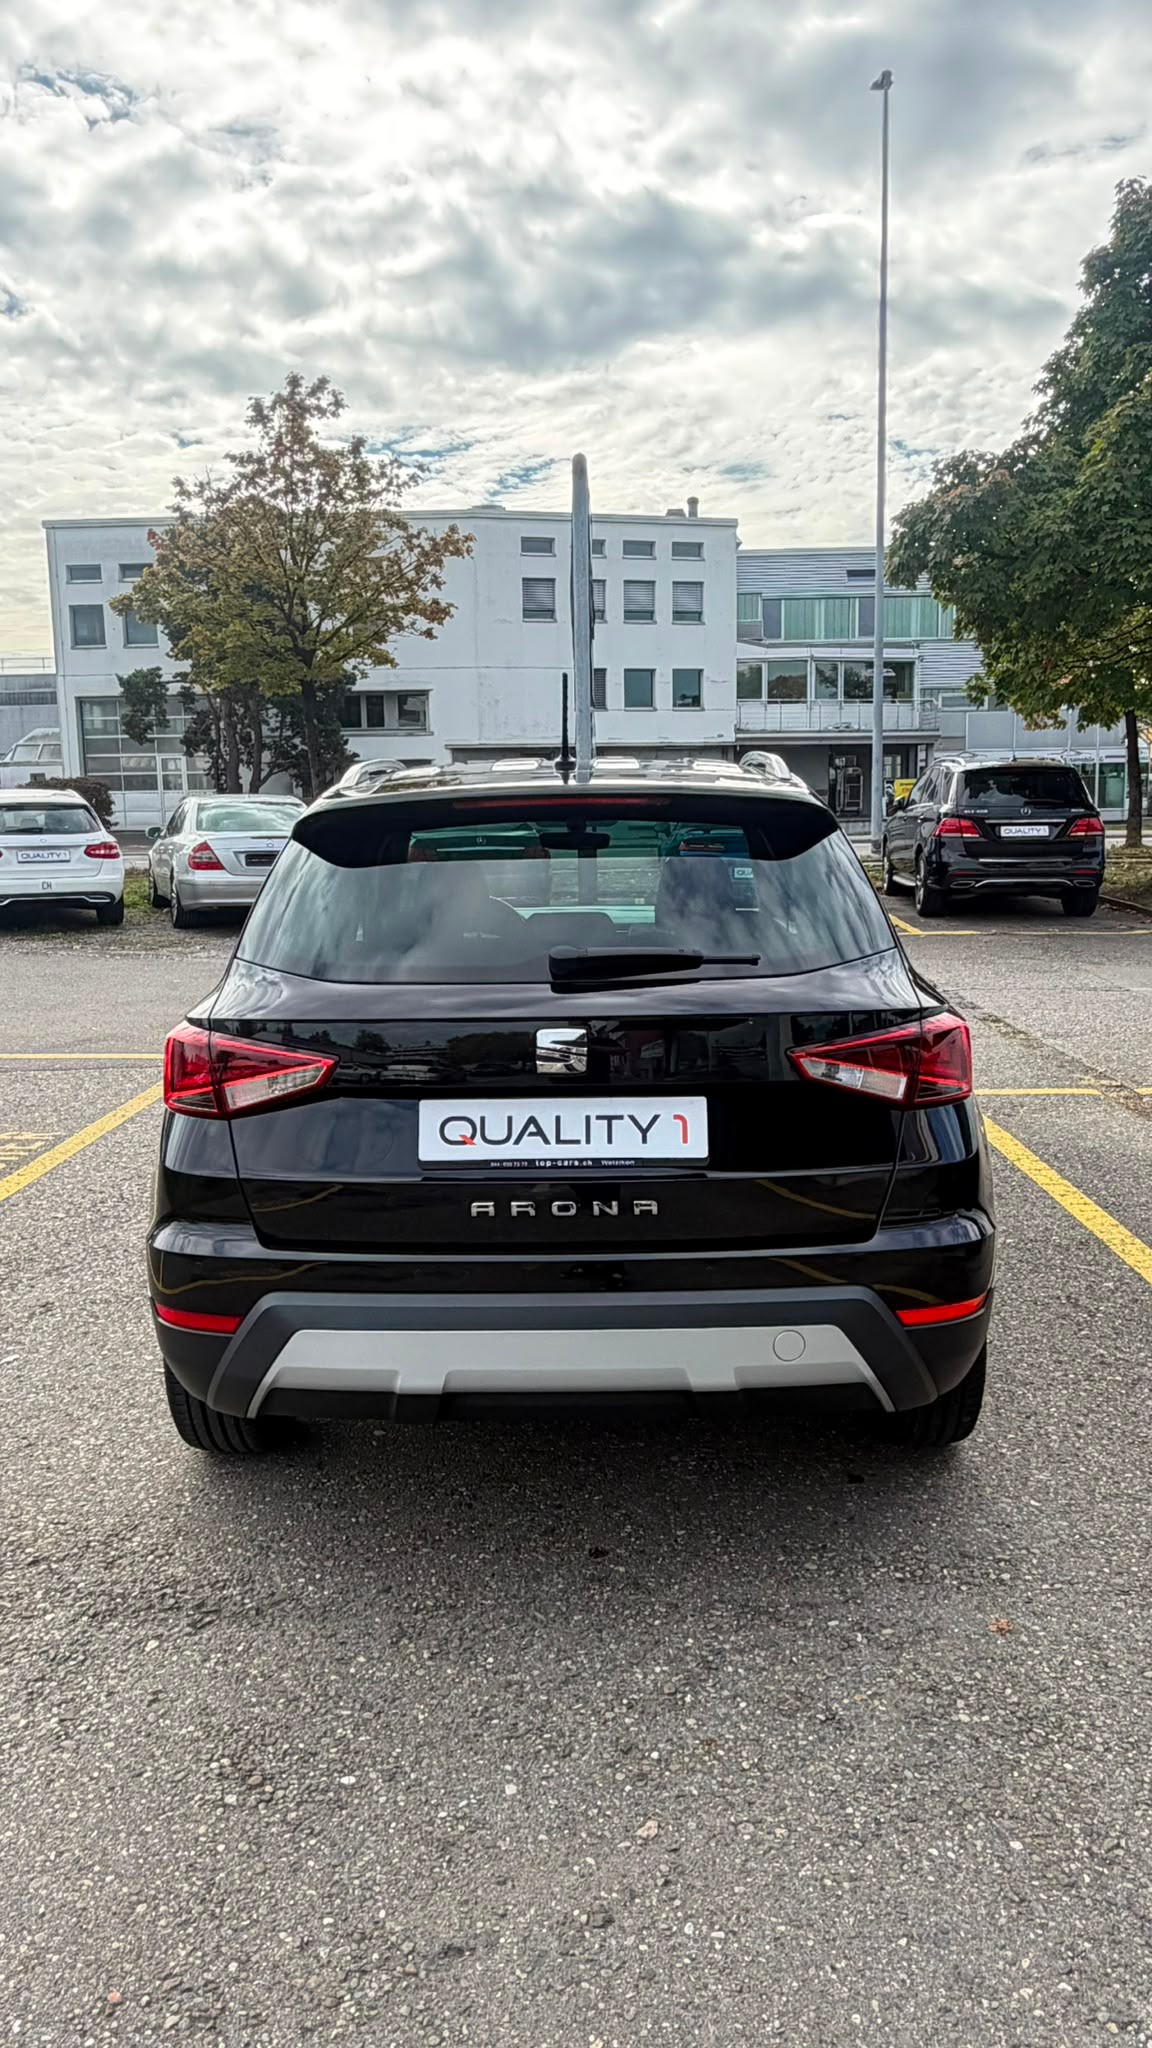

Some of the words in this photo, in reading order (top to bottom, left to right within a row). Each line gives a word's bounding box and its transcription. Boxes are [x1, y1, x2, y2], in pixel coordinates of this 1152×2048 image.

[41, 881, 52, 890] CH
[439, 1114, 661, 1145] QUALITY
[673, 1114, 689, 1144] 1
[535, 1159, 593, 1168] top-cars.ch
[470, 1200, 658, 1217] ARONA
